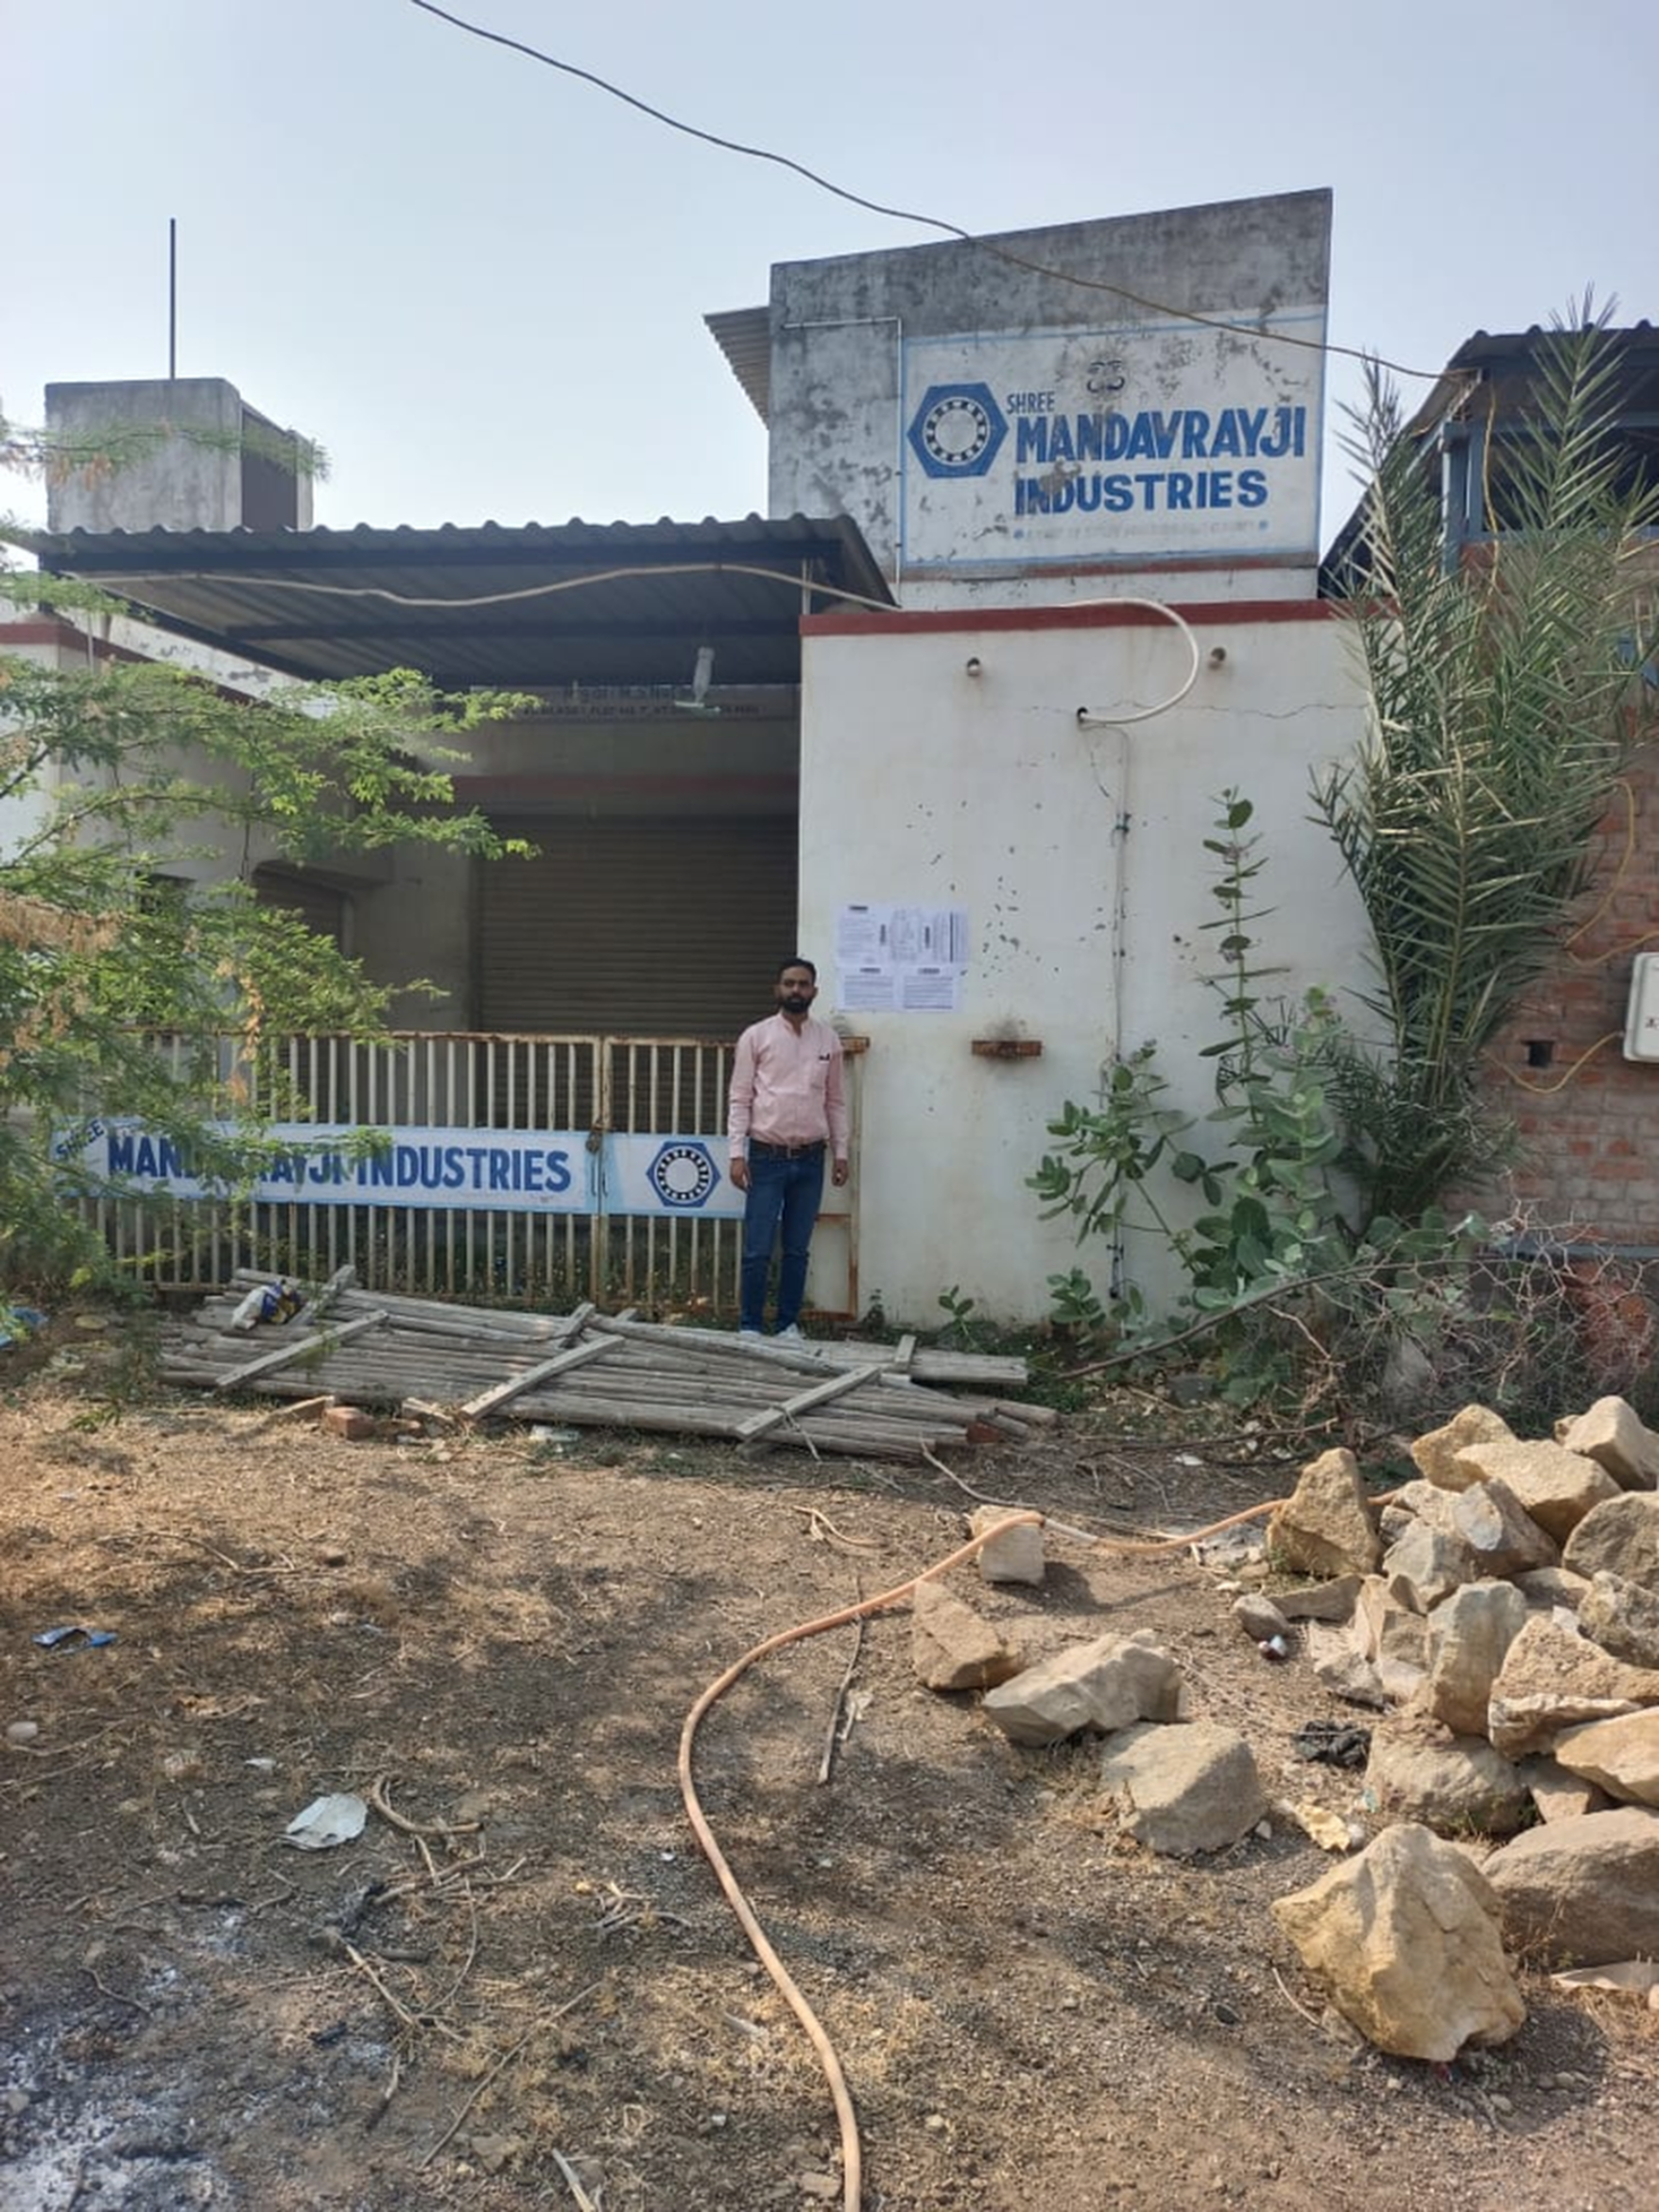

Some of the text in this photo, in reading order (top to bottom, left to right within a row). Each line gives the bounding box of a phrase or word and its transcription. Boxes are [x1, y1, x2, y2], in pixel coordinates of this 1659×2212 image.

[1006, 391, 1055, 414] SHREE
[1016, 406, 1306, 464] MANDAVRAYJI
[1015, 469, 1268, 516] INDUSTRIES
[357, 1144, 571, 1192] INDUSTRIES
